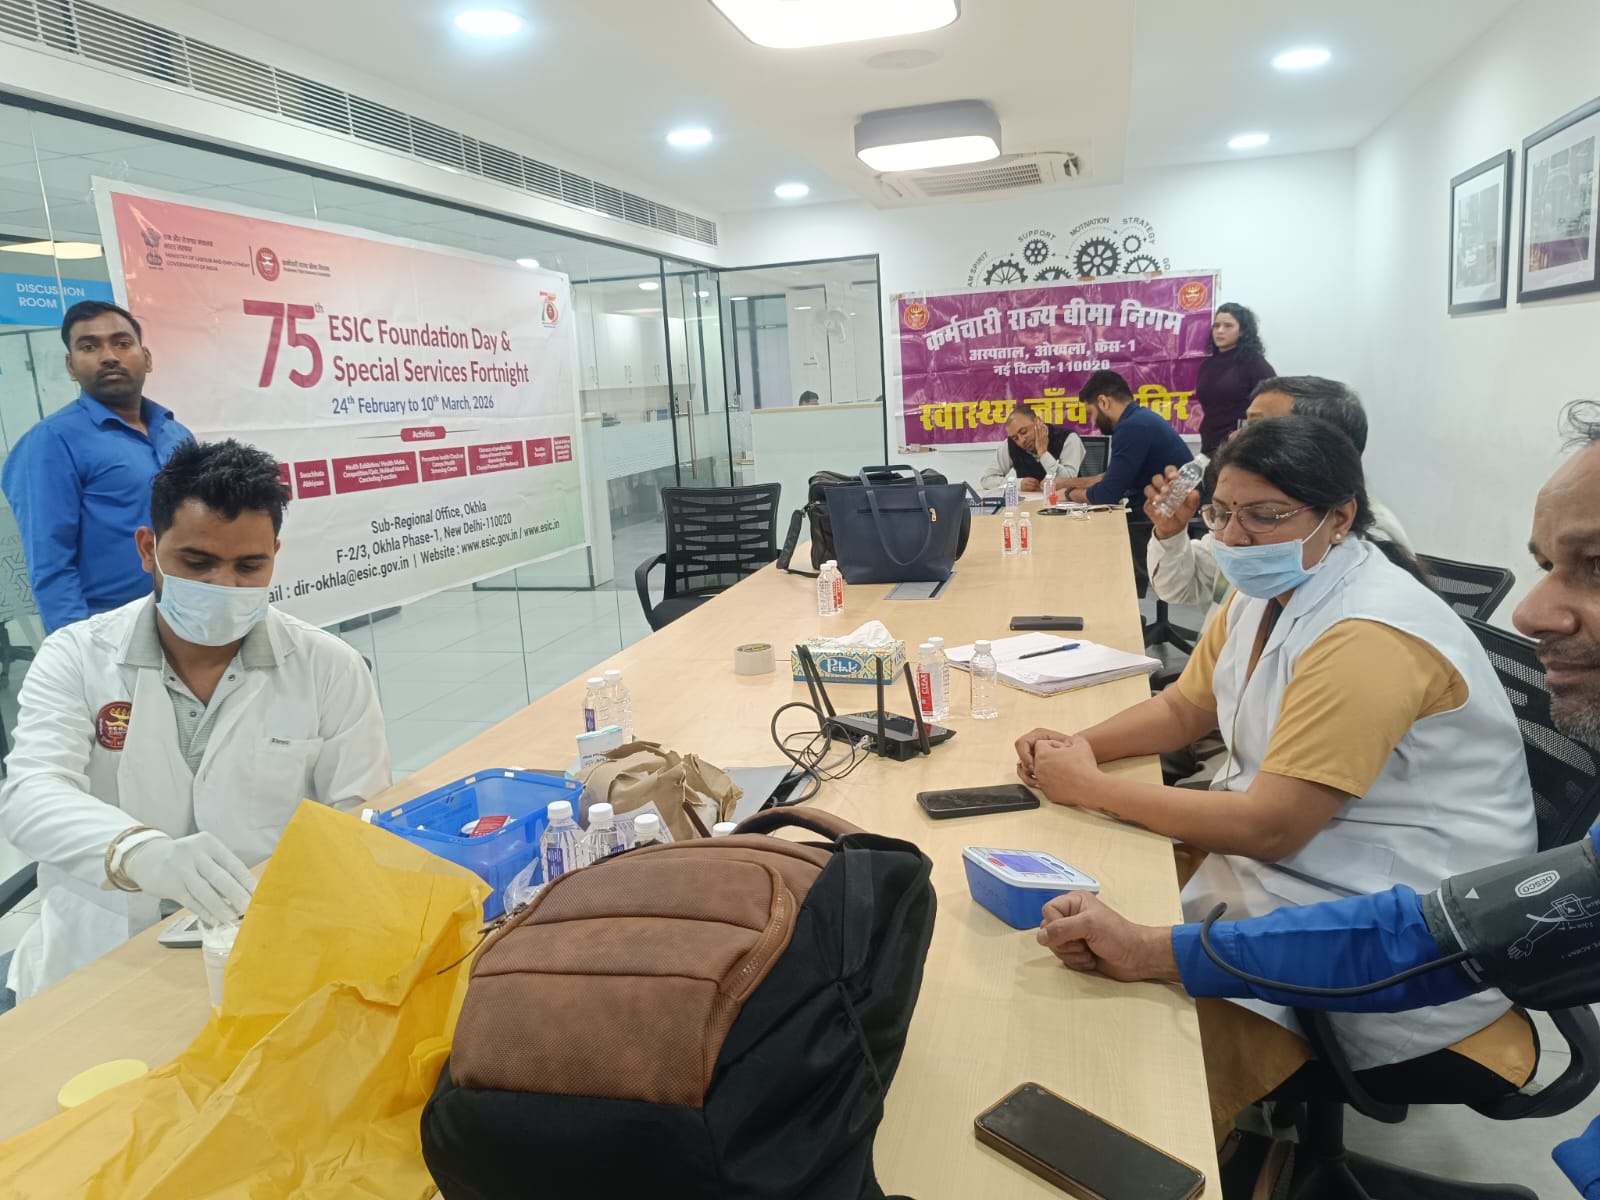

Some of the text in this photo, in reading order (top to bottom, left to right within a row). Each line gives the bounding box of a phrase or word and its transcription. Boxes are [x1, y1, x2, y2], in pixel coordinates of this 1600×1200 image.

[1017, 229, 1056, 242] SUPPORT
[1069, 217, 1110, 236] MOTIVATION
[1122, 217, 1155, 245] STRATEGY
[970, 251, 988, 274] SPIRIT
[16, 283, 86, 297] DISCUSION
[18, 296, 58, 308] ROOM
[328, 314, 512, 355] ESIC Foundation Day &
[922, 297, 1186, 351] कर्मचारी राज्य बीमा निगम
[969, 345, 1031, 361] अस्पताल,
[1034, 341, 1092, 357] ओखला,
[333, 355, 530, 388] Special Services Fortnight
[993, 359, 1110, 377] नई दिल्ली-110020
[331, 394, 495, 415] 24th February to 10th March, 2026
[918, 399, 1017, 431] स्वास्थ्य
[1133, 384, 1193, 420] विर
[412, 430, 436, 439] Activities
[371, 500, 487, 534] Sub-Regional Office, Okhla
[336, 512, 512, 564] F-2/3, Okhla Phase-1, New Delhi-110020
[268, 584, 283, 603] ail
[294, 556, 410, 596] dir-okhla@esic.gov.in
[420, 545, 456, 565] Website
[461, 528, 518, 554] www.esic.gov.in
[523, 518, 560, 537] www.esic.in
[1521, 874, 1554, 893] DESCO
